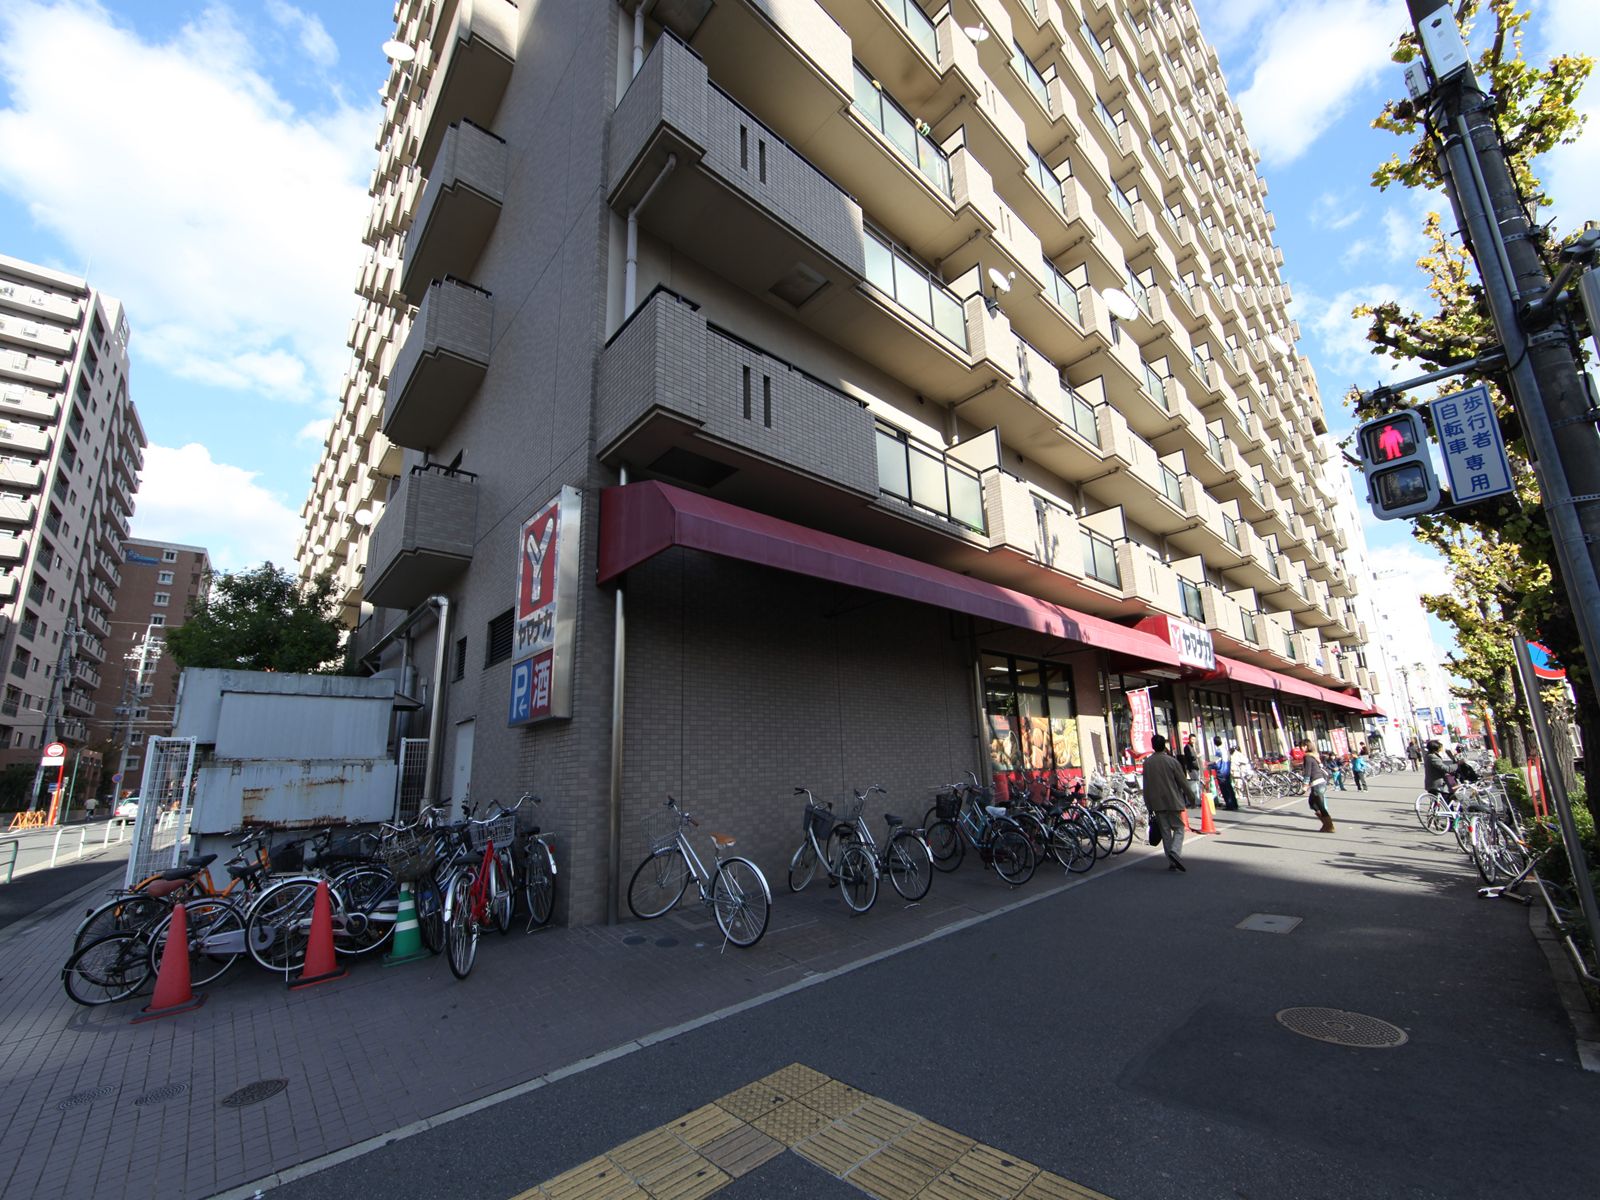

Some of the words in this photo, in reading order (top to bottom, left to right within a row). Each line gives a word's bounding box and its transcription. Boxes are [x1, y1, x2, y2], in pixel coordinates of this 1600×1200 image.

[1440, 403, 1468, 455] 自転車
[1463, 394, 1492, 449] 歩行者
[1465, 453, 1491, 493] 専用
[527, 514, 555, 604] Y
[518, 611, 553, 650] ヤマナカ
[1182, 628, 1212, 662] ヤマナカ
[512, 666, 528, 719] P
[532, 661, 551, 709] 酒
